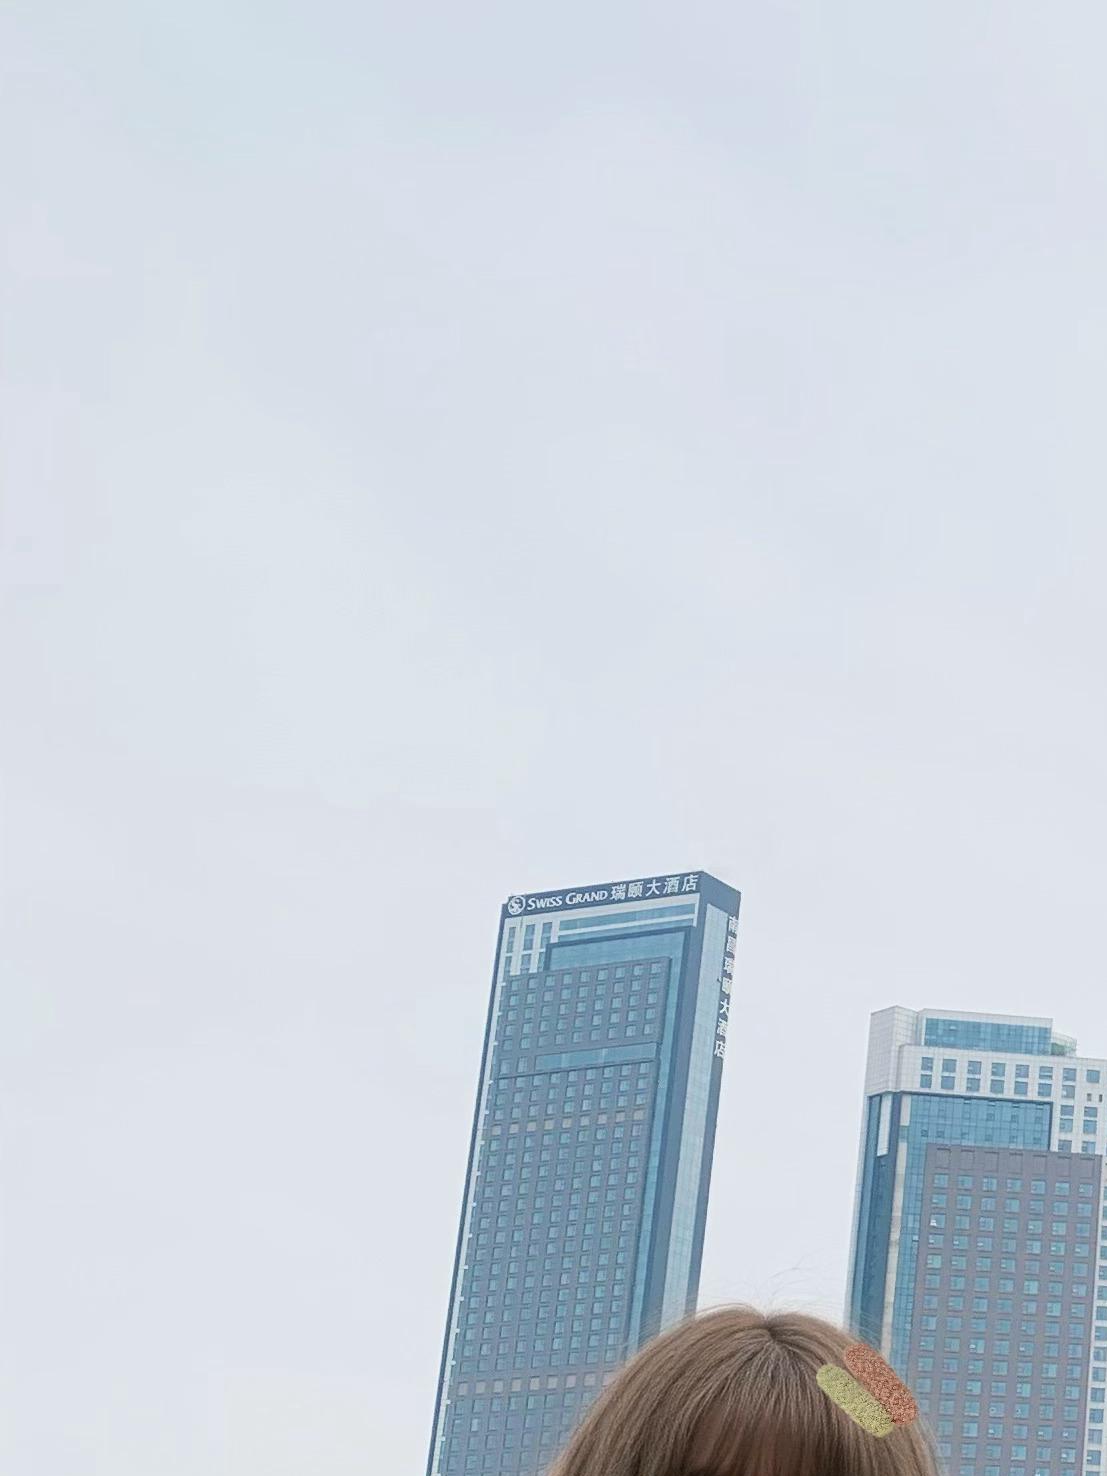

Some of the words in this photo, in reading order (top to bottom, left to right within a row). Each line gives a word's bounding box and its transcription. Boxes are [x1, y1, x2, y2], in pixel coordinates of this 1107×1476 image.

[610, 874, 699, 901] 瑞颐大酒店
[527, 895, 563, 911] SWISS
[565, 890, 608, 905] GRAND
